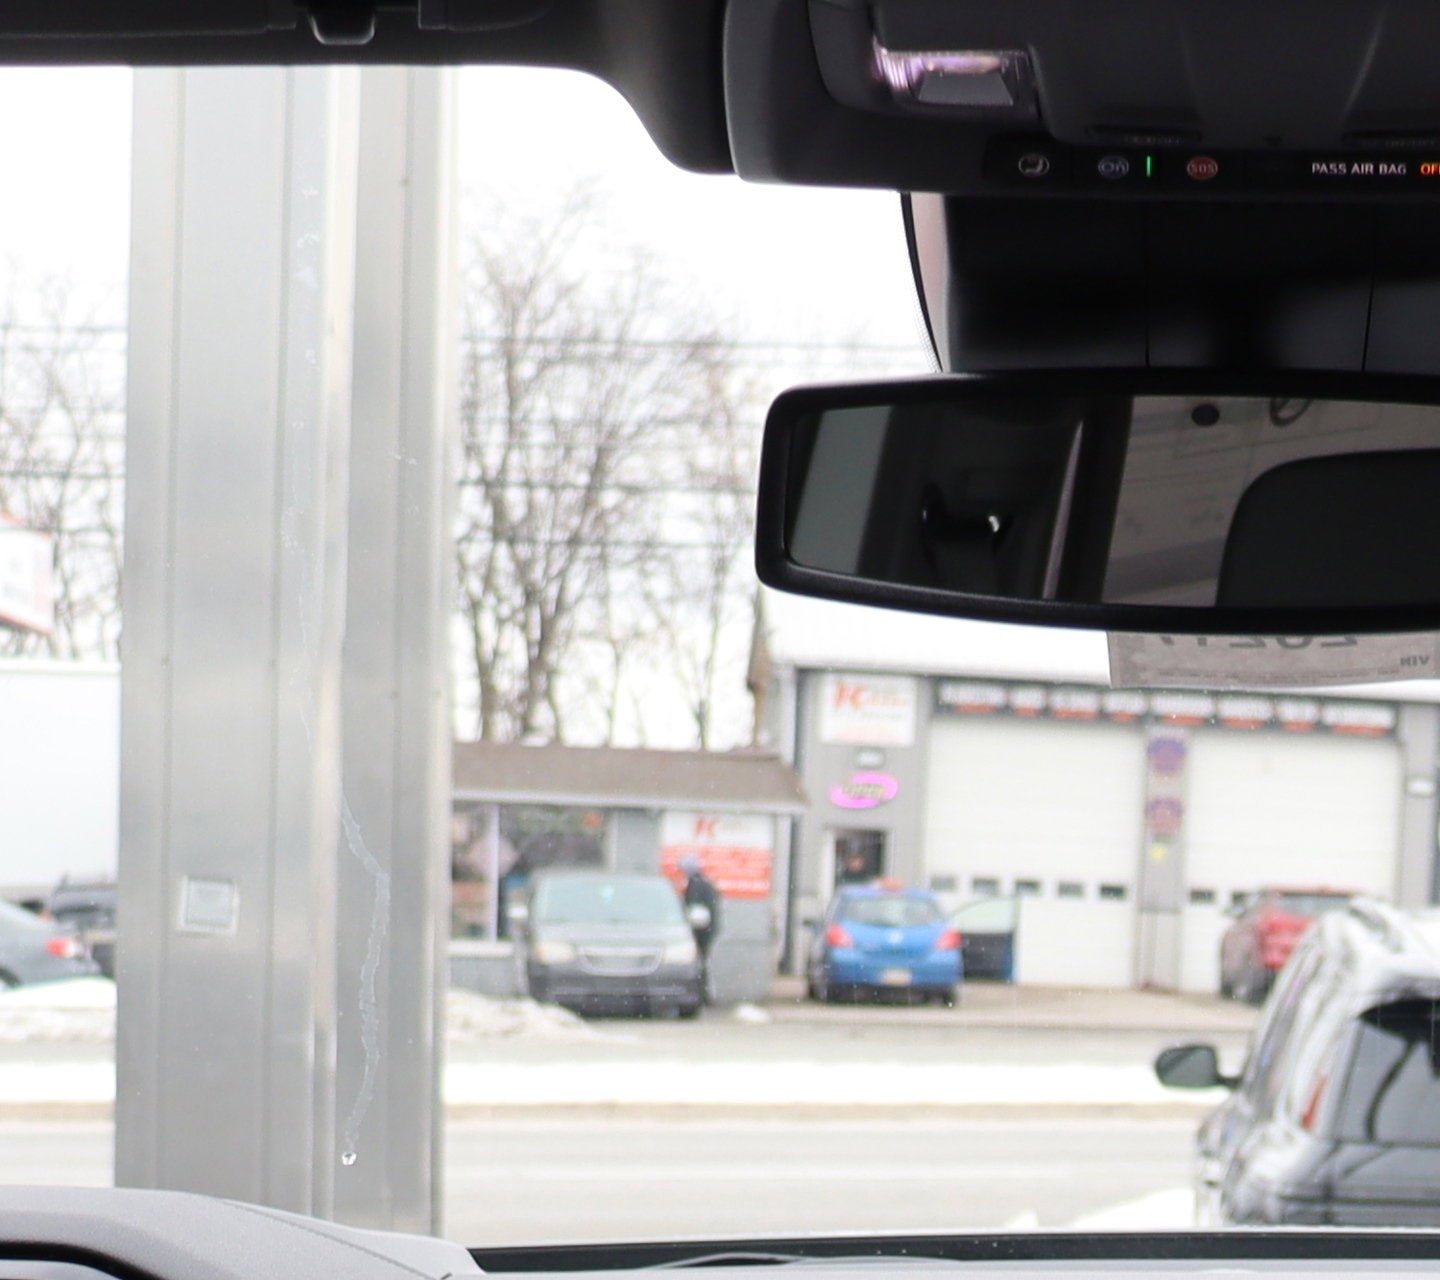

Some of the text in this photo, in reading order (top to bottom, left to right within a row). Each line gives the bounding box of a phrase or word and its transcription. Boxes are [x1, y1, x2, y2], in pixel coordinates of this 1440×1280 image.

[1312, 162, 1347, 175] PASS
[1351, 162, 1376, 175] AIR
[1379, 162, 1408, 175] BAG
